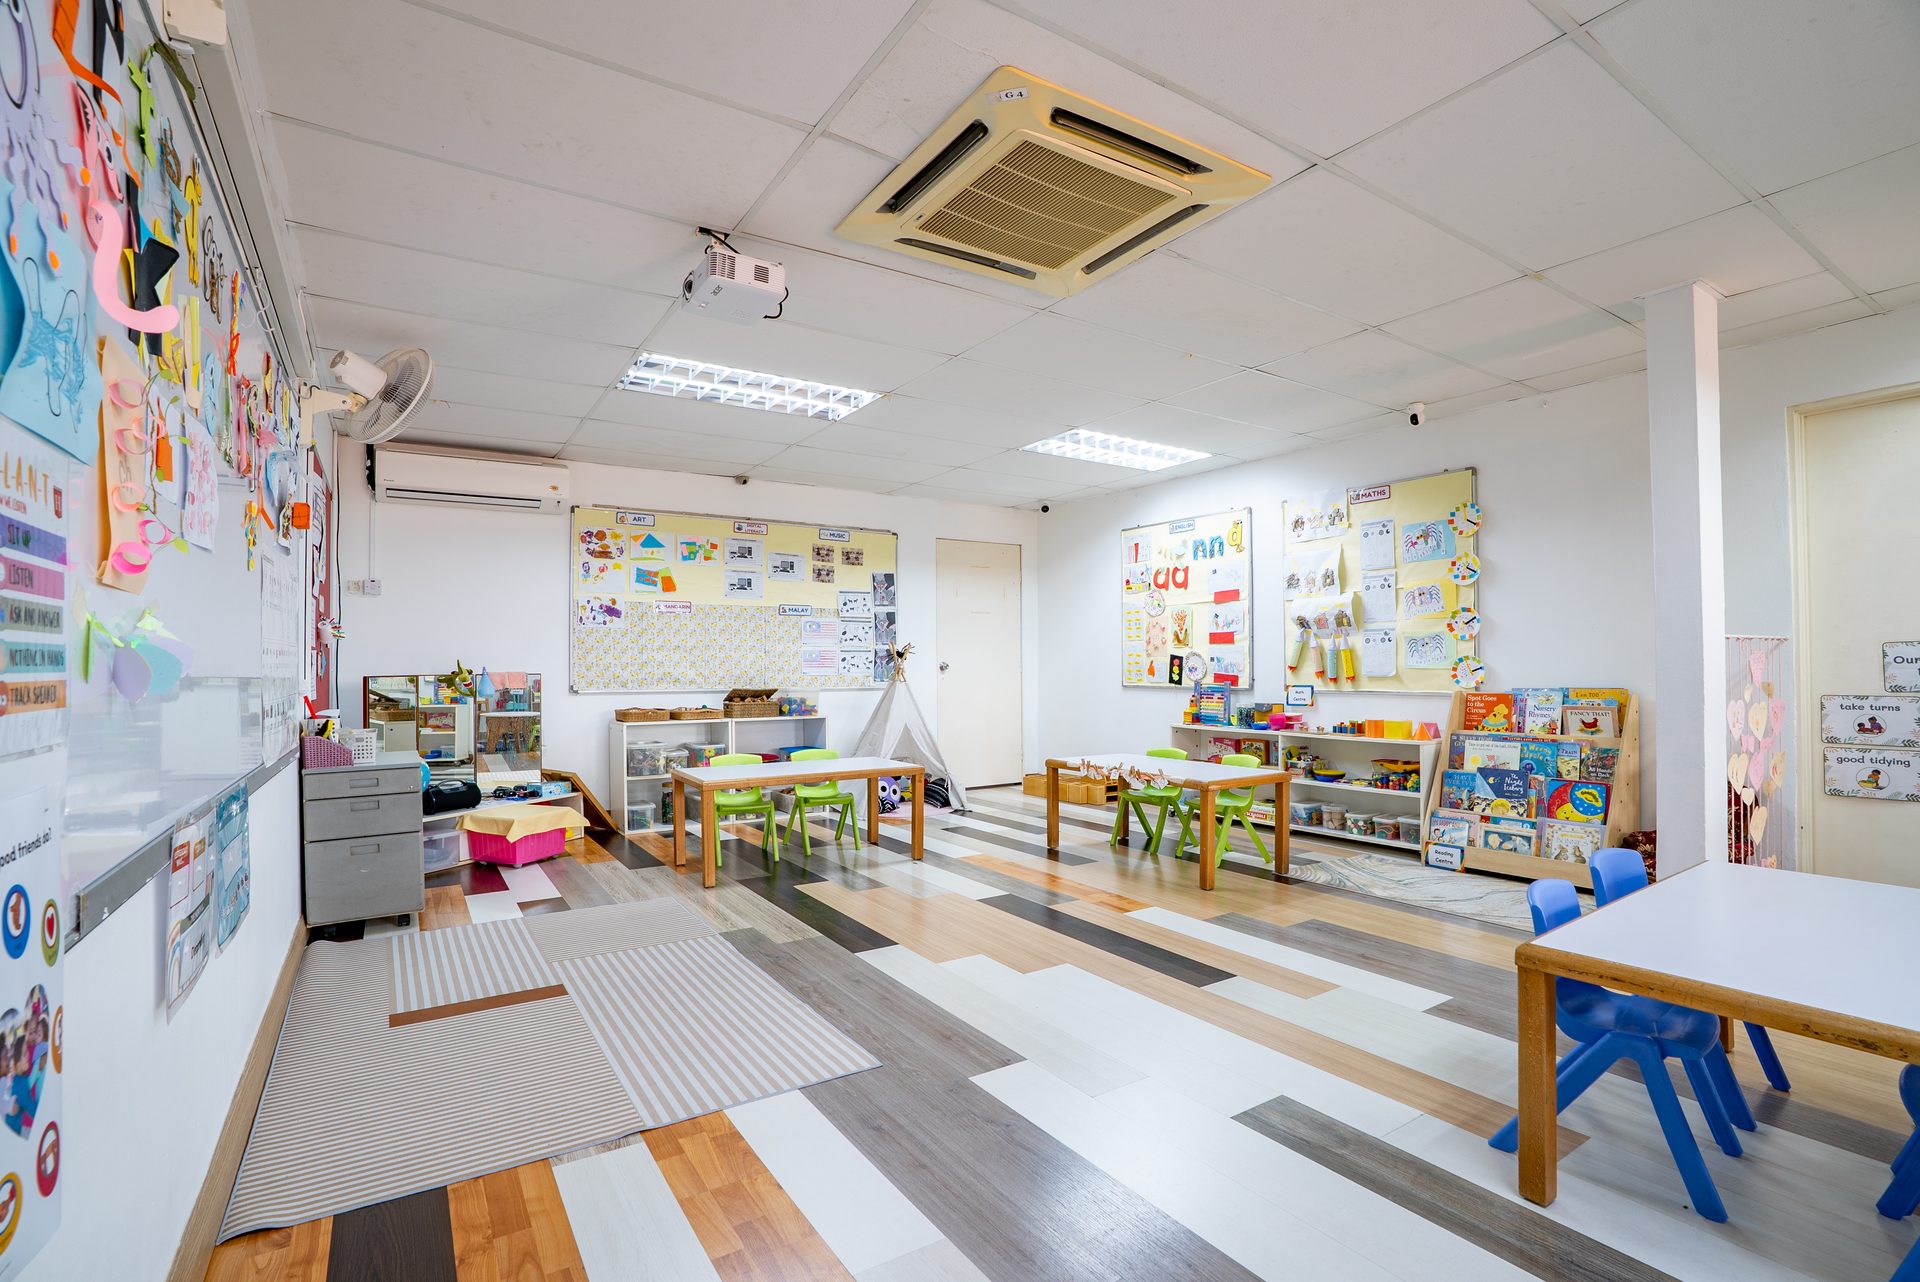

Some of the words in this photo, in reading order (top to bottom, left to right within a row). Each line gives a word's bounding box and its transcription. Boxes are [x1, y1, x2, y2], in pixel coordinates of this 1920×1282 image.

[1361, 489, 1386, 499] MATHS
[1174, 523, 1194, 531] ENGLISH
[829, 532, 846, 540] MUSIC
[9, 563, 34, 589] LISTEN
[9, 603, 22, 625] ASK
[23, 606, 36, 626] AND
[1893, 655, 1920, 665] Our
[10, 686, 31, 707] TRACK
[1533, 704, 1556, 712] Nursery
[1840, 703, 1865, 711] take
[1869, 703, 1901, 712] turns
[1528, 710, 1551, 718] Rhymes
[1836, 755, 1865, 764] good
[1869, 756, 1911, 768] tidying
[0, 845, 16, 867] ood
[18, 834, 41, 858] friends
[1435, 849, 1454, 858] Reading
